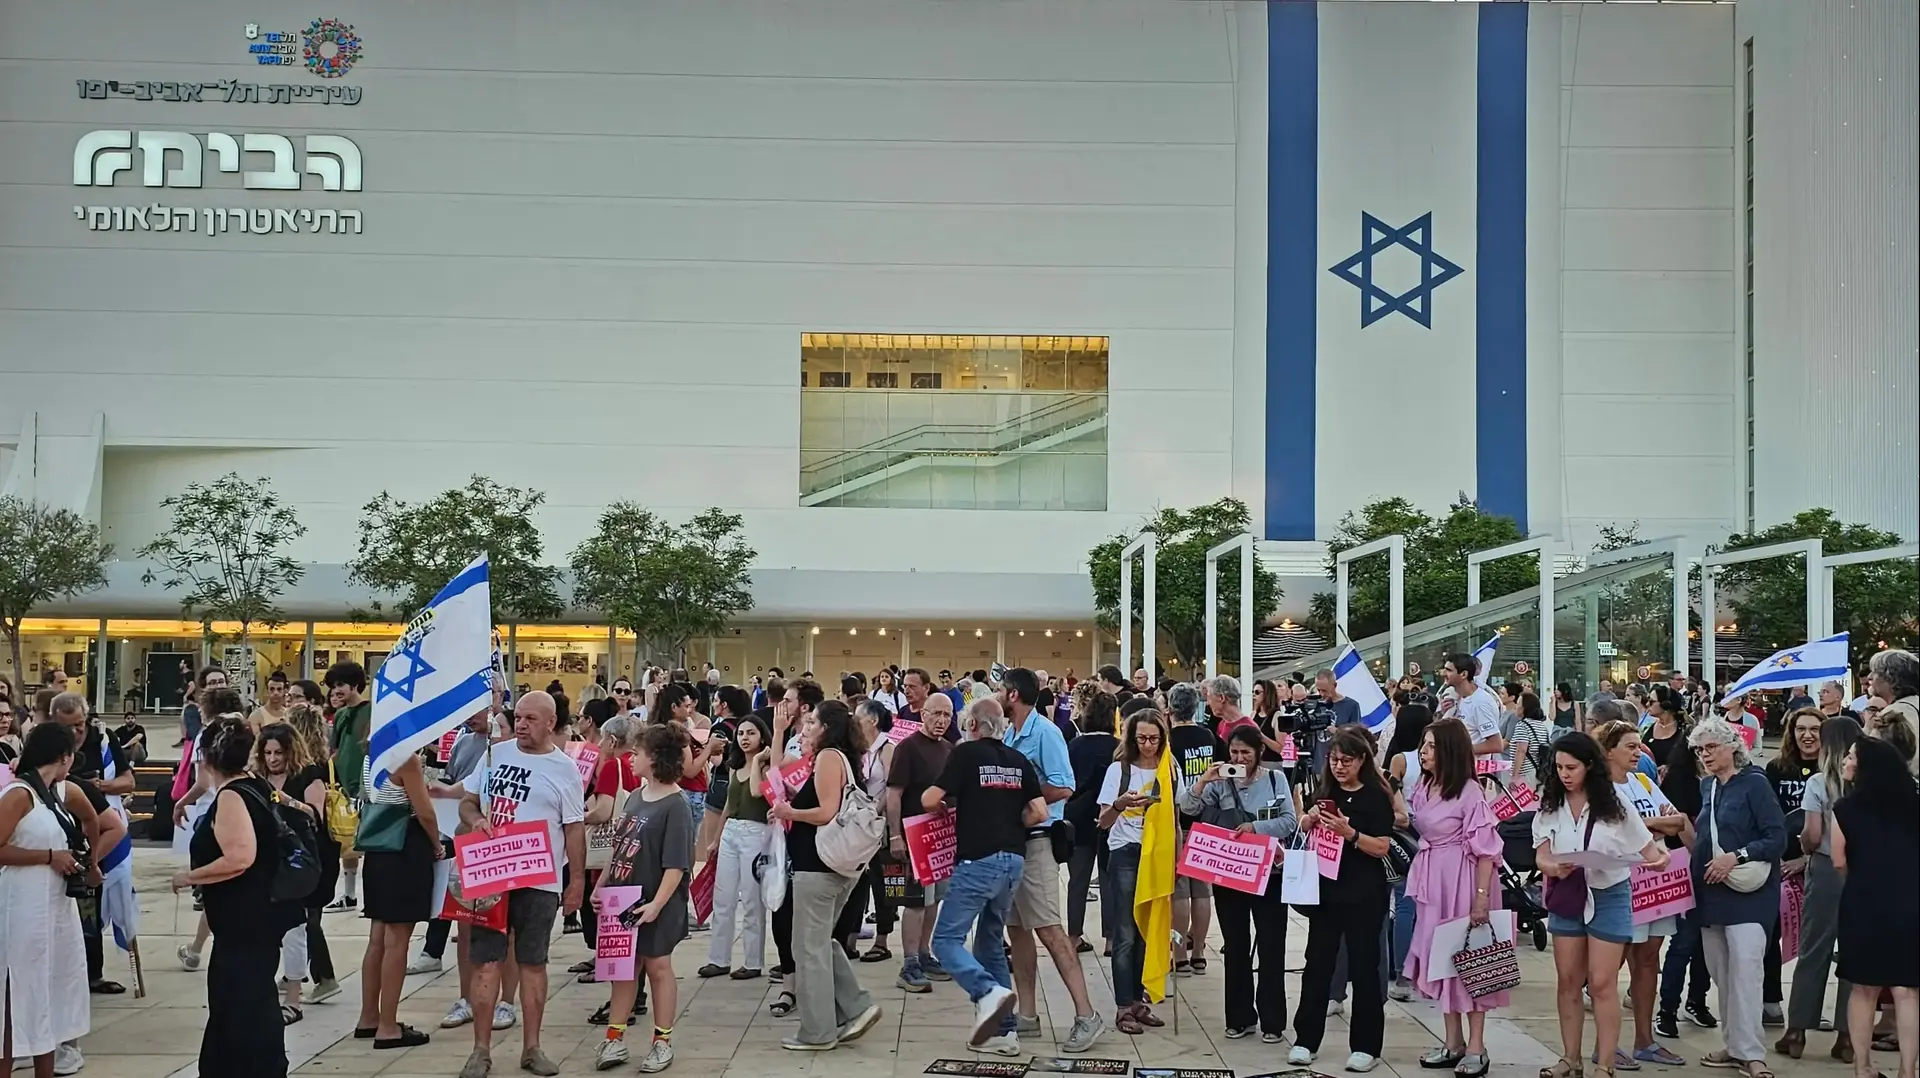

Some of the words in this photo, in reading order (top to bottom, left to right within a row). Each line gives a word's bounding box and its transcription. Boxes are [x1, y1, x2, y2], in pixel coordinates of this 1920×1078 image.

[269, 85, 362, 105] עיריית
[73, 130, 363, 191] הבימה
[73, 203, 196, 233] הלאומי
[203, 207, 362, 236] התיאטרון
[1185, 748, 1197, 759] ALL
[494, 764, 532, 784] אתה
[468, 840, 523, 859] שהפקיר
[526, 838, 540, 849] מי
[1194, 835, 1217, 850] חייב
[1219, 840, 1260, 859] להחזיר
[1318, 846, 1336, 860] NOW
[468, 862, 517, 881] להחזיר
[521, 857, 547, 871] חייב
[1191, 854, 1203, 864] מי
[1206, 858, 1252, 877] שהפקיר
[1663, 867, 1688, 883] נשים
[1632, 876, 1659, 893] דורש
[1658, 883, 1688, 900] עסקה
[1633, 893, 1656, 908] עכש
[609, 936, 630, 948] הצילו
